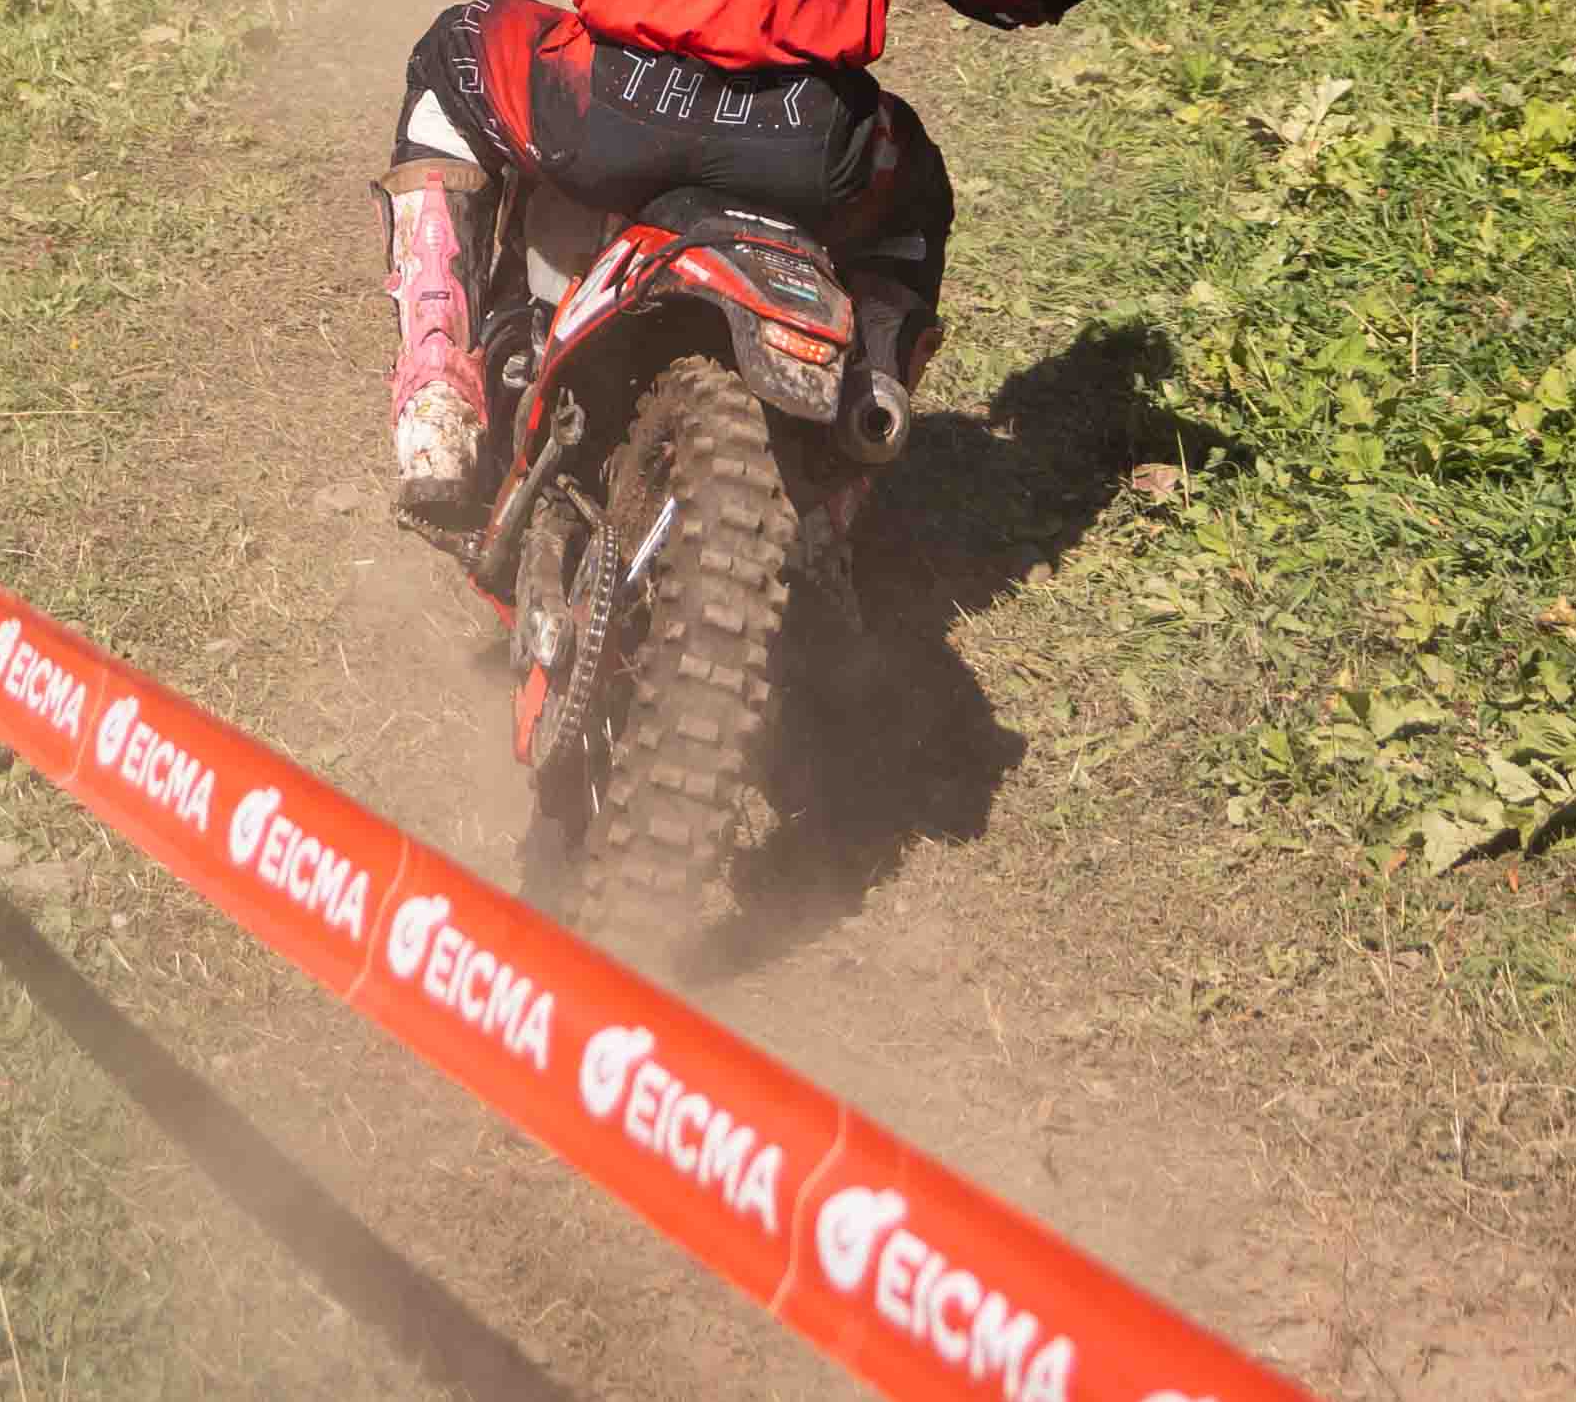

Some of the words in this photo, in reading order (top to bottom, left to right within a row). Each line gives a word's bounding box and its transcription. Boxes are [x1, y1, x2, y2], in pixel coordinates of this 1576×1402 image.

[4, 642, 86, 738] EICMA
[121, 722, 214, 832] EICMA
[258, 815, 369, 940] EICMA
[423, 925, 555, 1070] EICMA
[624, 1060, 783, 1235] EICMA
[874, 1228, 1076, 1402] EICMA
